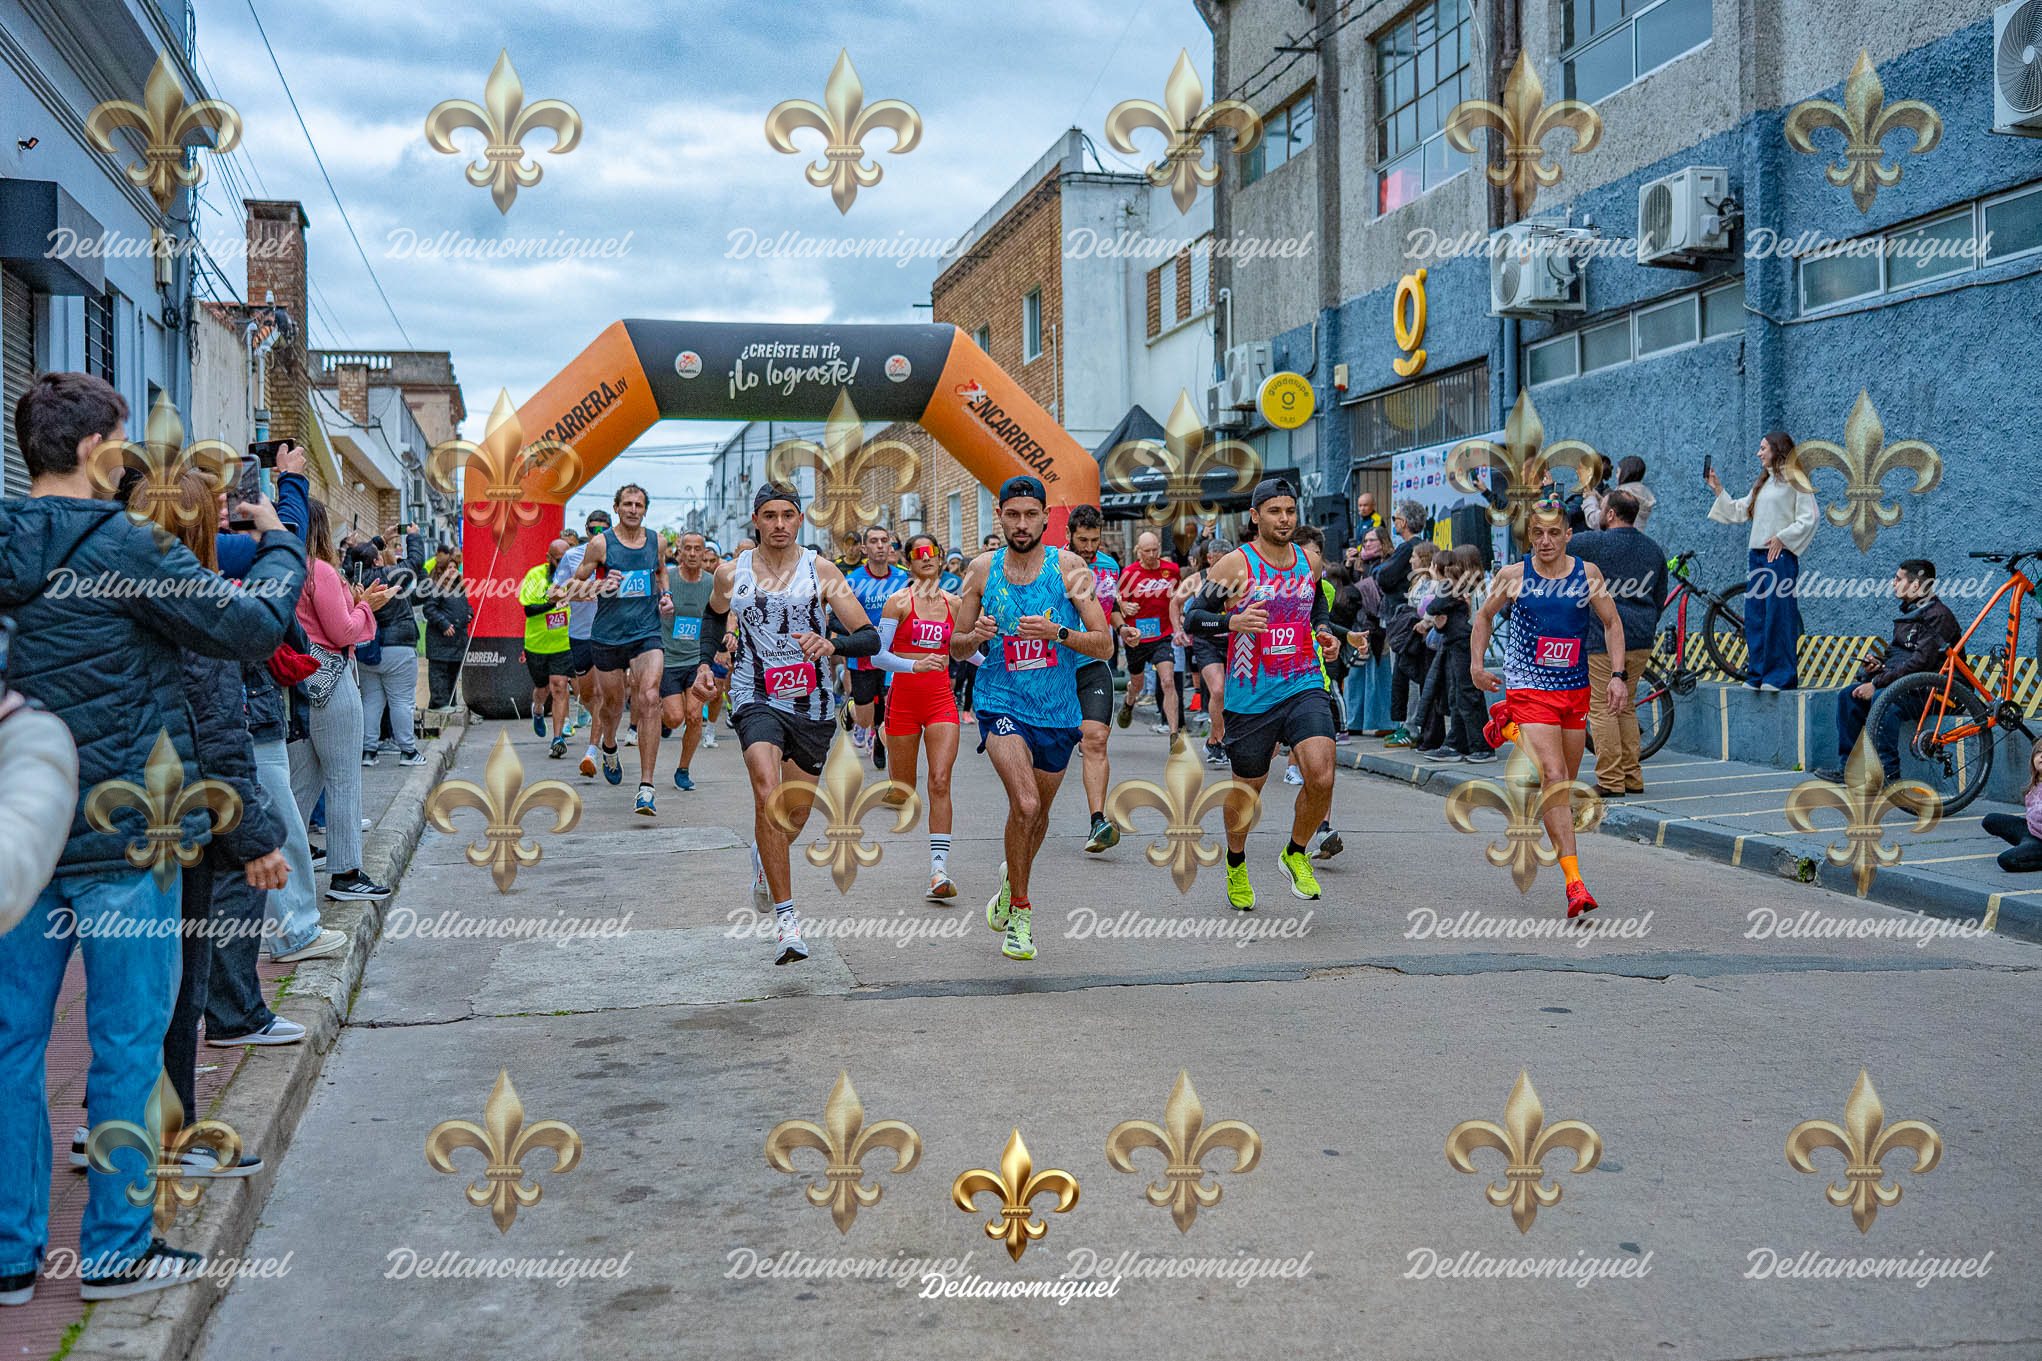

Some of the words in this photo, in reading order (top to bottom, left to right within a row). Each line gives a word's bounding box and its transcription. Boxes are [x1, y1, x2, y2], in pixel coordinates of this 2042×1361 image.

[741, 341, 800, 360] ¿CREÍSTE
[801, 344, 820, 359] EN
[822, 342, 841, 359] TÍ?
[766, 356, 860, 396] lograste!
[626, 578, 645, 591] 413
[549, 614, 565, 625] 245
[678, 623, 697, 634] 378
[920, 624, 943, 641] 178
[1140, 623, 1157, 634] 359
[1270, 627, 1295, 645] 199
[1013, 640, 1043, 659] 179
[1542, 641, 1573, 658] 207
[772, 668, 808, 691] 234
